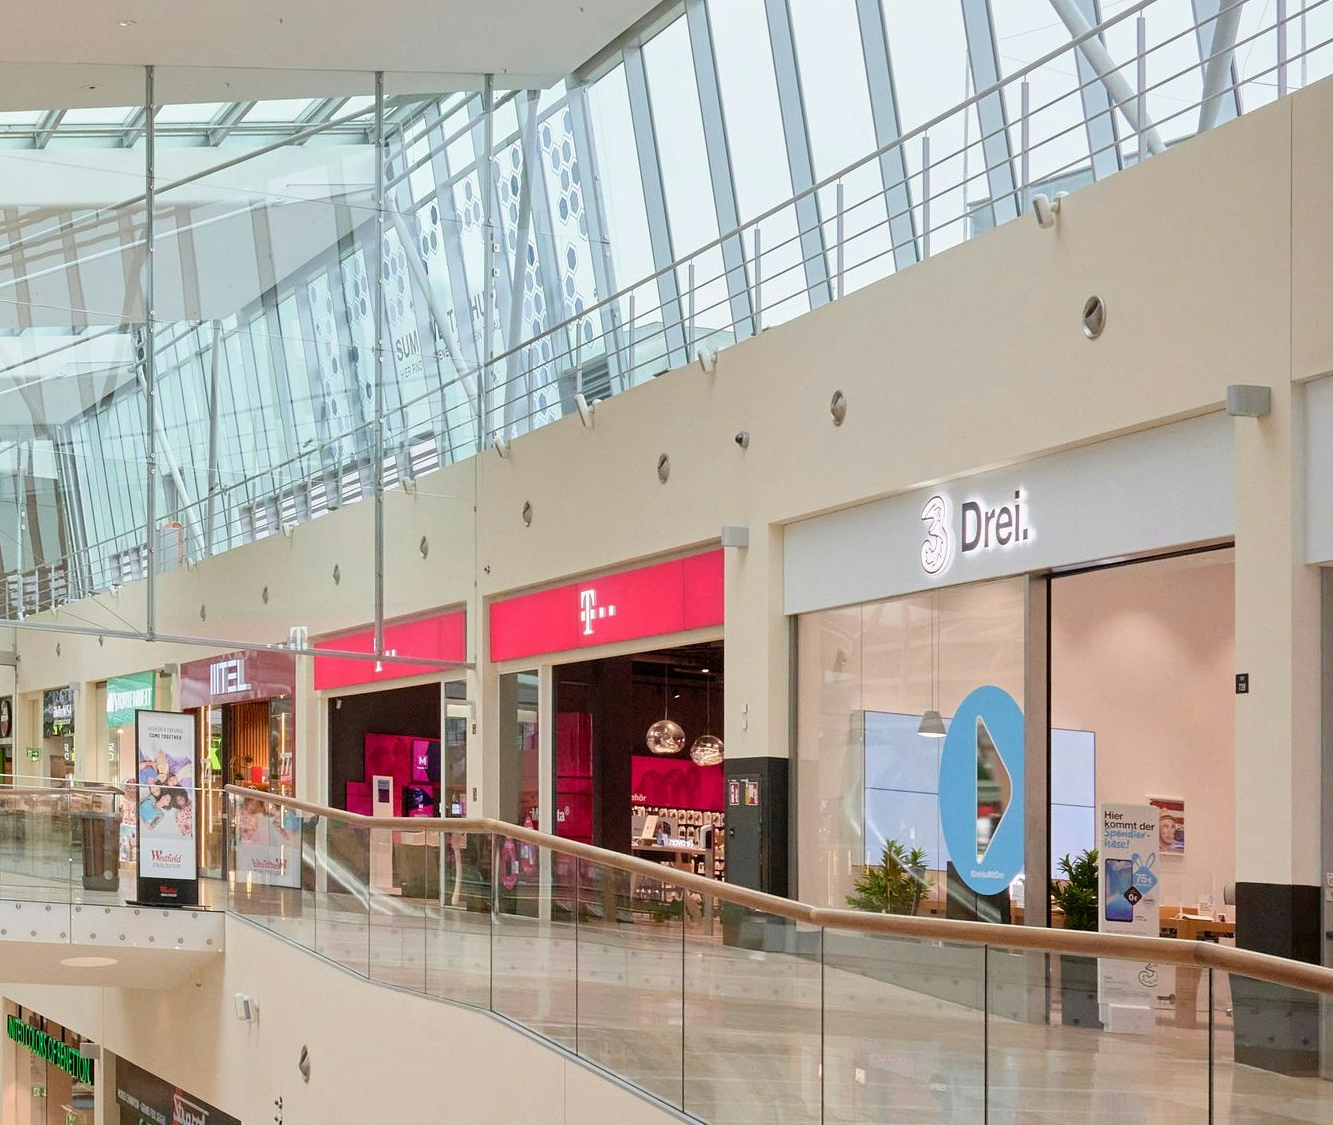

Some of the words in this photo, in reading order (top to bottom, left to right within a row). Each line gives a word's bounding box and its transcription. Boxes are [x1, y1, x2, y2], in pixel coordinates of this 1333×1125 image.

[961, 490, 1029, 553] Drei.
[1104, 810, 1124, 821] Hier
[1104, 820, 1137, 831] kommt
[1139, 822, 1155, 831] der
[151, 849, 182, 863] Westfield
